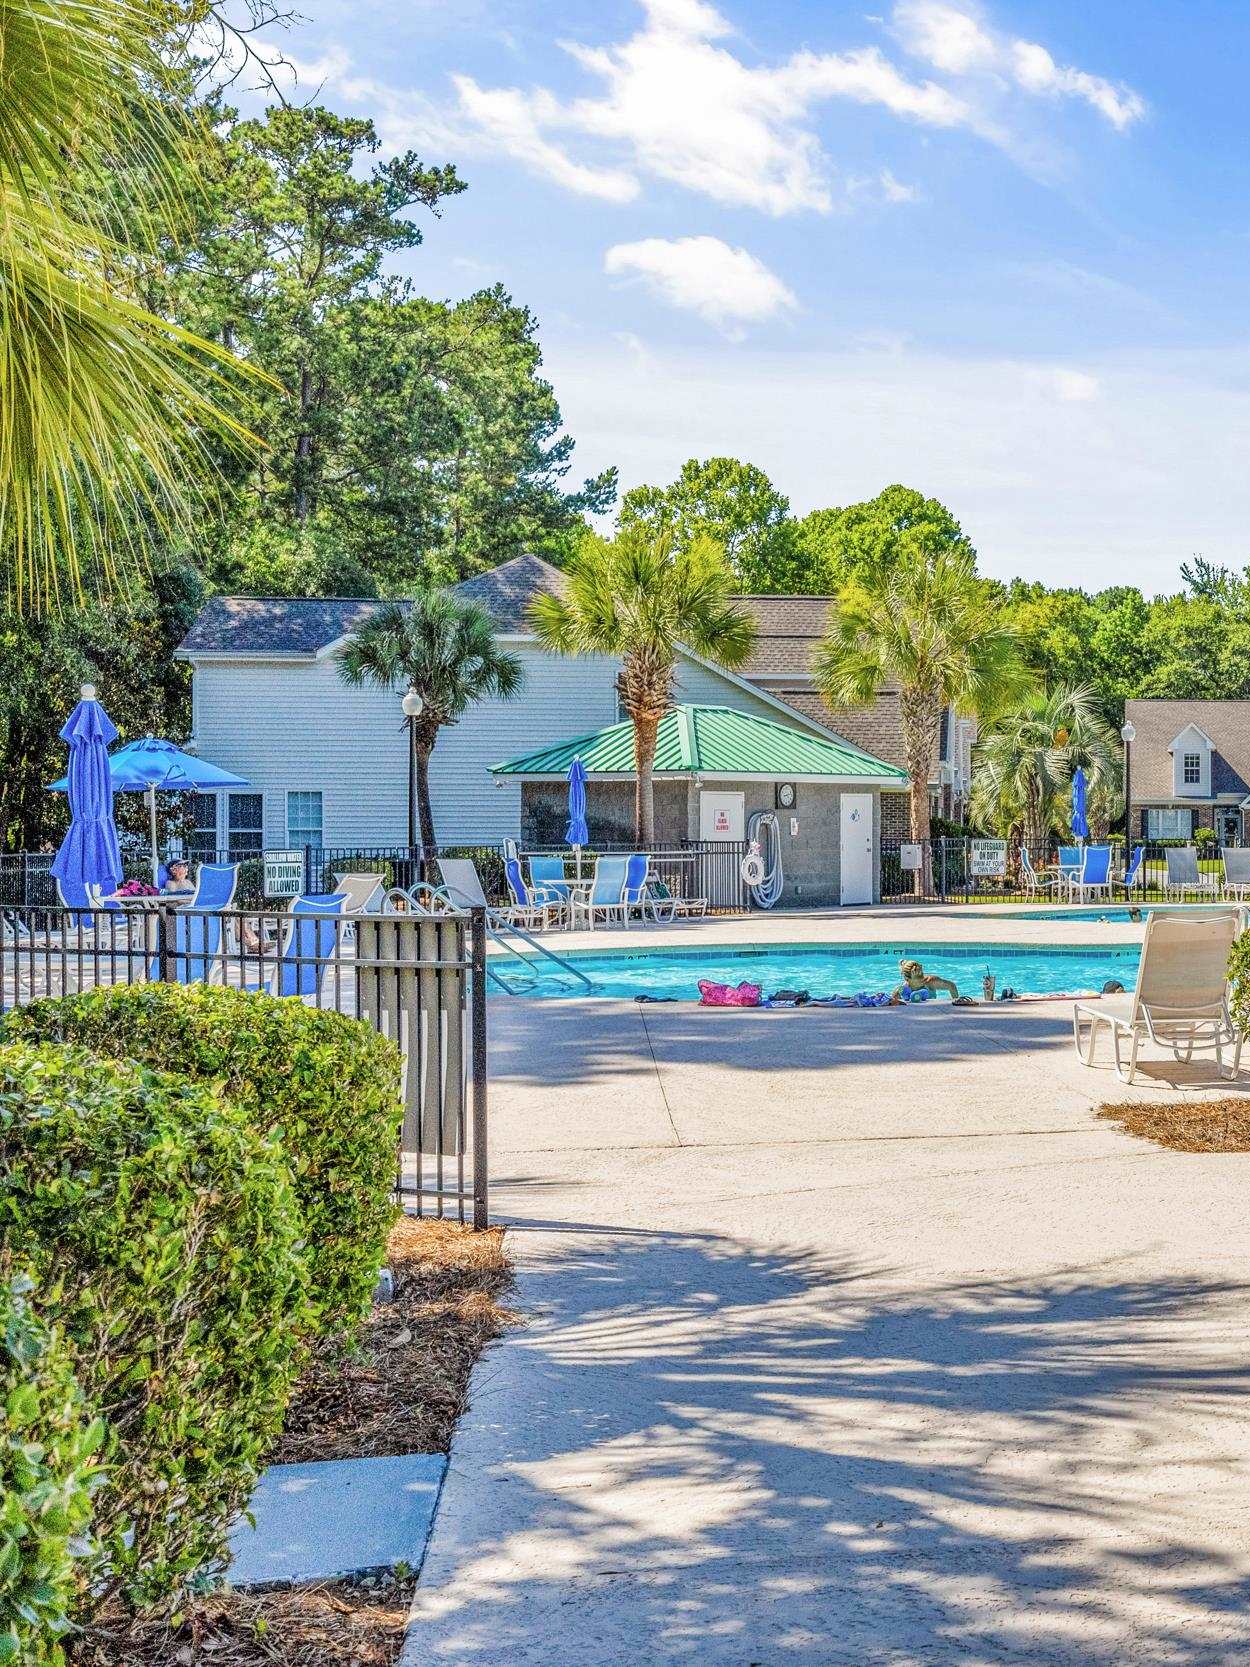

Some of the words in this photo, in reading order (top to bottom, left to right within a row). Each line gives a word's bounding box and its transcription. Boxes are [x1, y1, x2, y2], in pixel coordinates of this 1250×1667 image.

[974, 842, 980, 851] NO
[980, 842, 1004, 850] LIFEGUARD
[979, 851, 986, 860] ON
[987, 851, 999, 860] DUTY
[267, 865, 277, 879] NO
[278, 865, 301, 879] DIVING
[268, 880, 300, 893] ALLOWED
